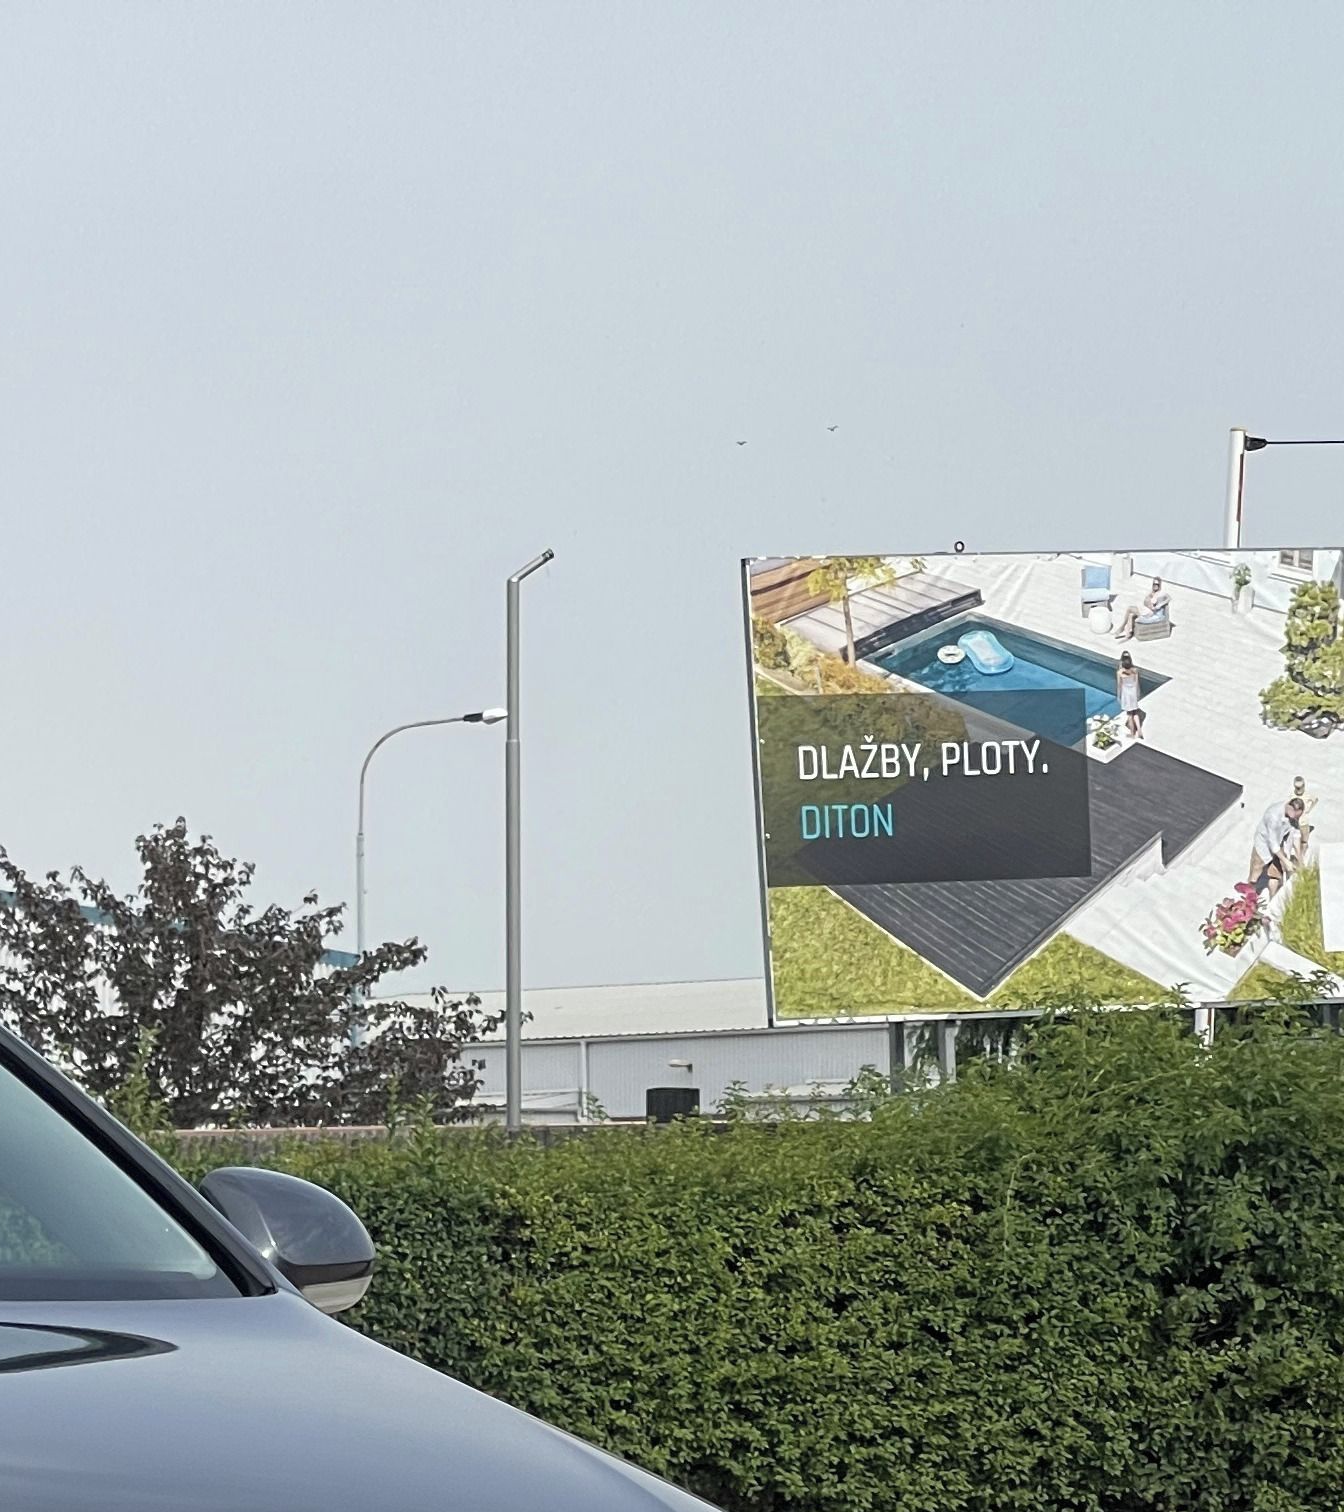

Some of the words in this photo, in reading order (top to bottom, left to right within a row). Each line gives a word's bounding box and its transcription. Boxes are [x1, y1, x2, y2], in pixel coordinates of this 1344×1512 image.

[797, 734, 930, 782] DLAŽBY,
[941, 739, 1049, 777] PLOTY.
[800, 803, 894, 840] DITON
